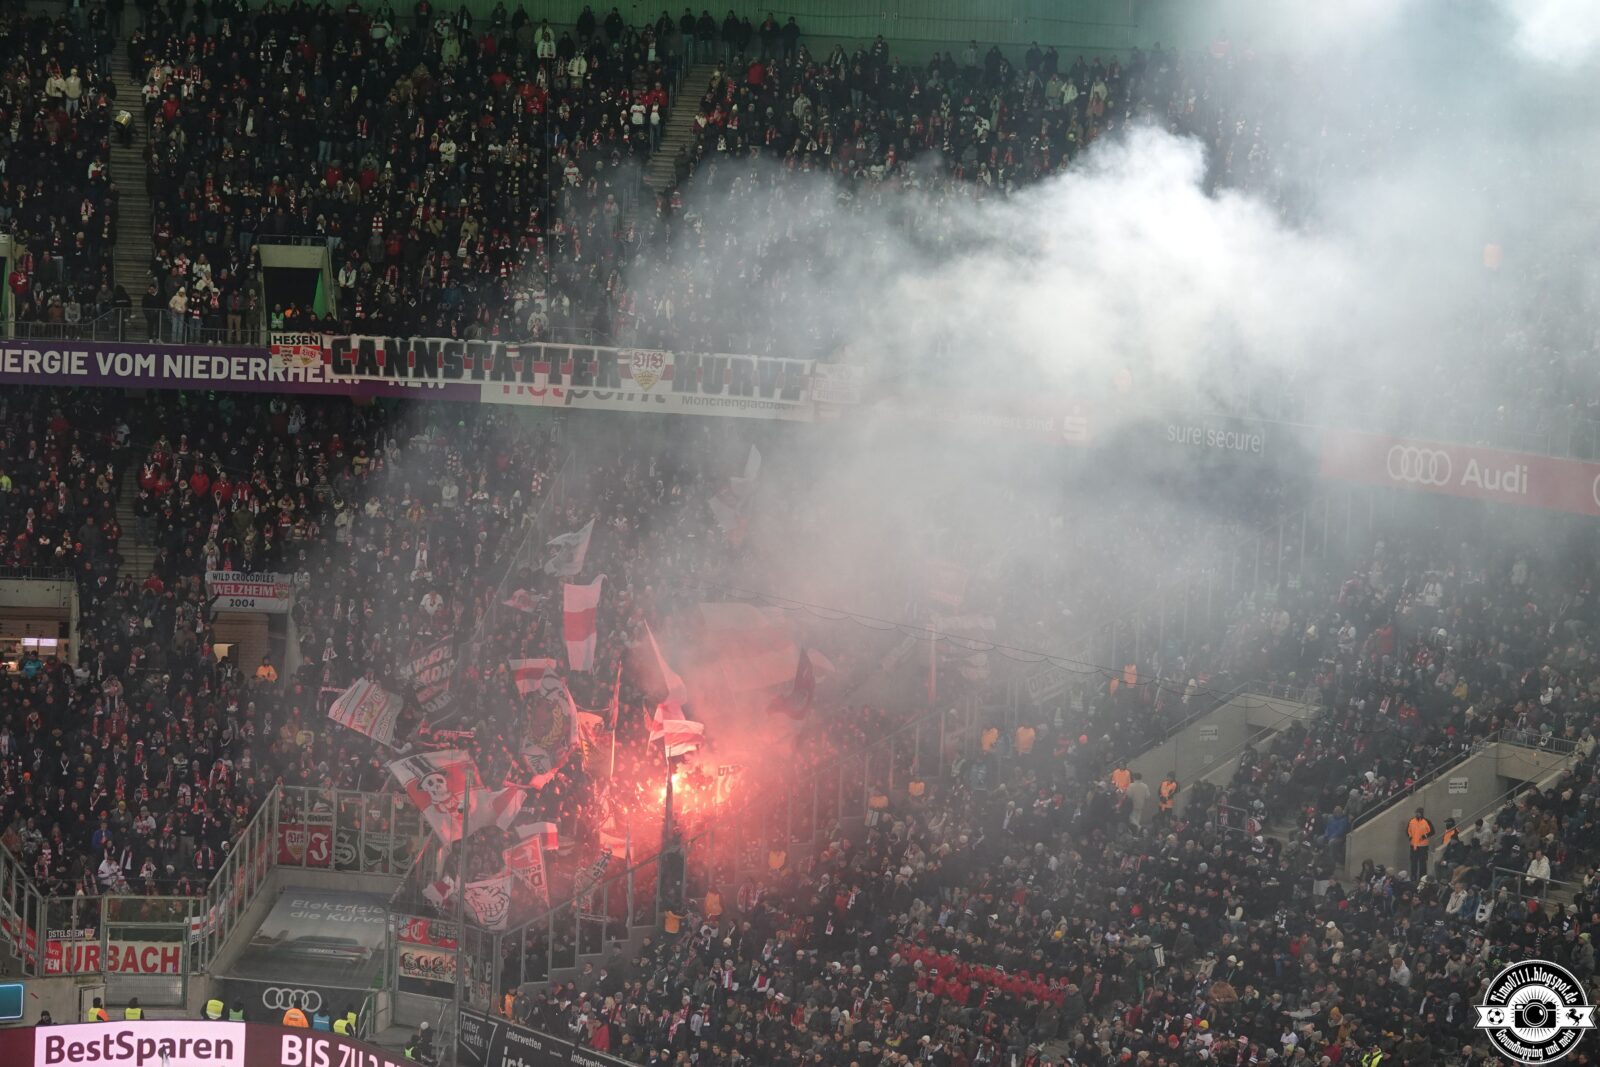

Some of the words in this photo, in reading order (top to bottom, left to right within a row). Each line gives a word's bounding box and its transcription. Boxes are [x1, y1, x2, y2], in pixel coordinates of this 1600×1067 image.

[273, 335, 319, 345] HESSEN
[0, 348, 89, 375] ERGIE
[96, 352, 156, 378] VOM
[163, 354, 360, 385] NIEDERRHE
[331, 336, 623, 389] CANNSTATTER
[1460, 458, 1529, 496] Audi
[212, 573, 230, 582] WILD
[231, 573, 275, 583] CROCODILES
[212, 584, 274, 597] WELZHEIM
[229, 599, 256, 608] 2004
[290, 900, 385, 914] Elektrisie
[289, 911, 321, 920] die
[326, 912, 385, 924] Kurve
[48, 929, 84, 938] OSTELSEIM
[65, 944, 180, 974] URBACH
[45, 1030, 234, 1066] BestSparen
[506, 1028, 542, 1051] interwetten
[281, 1034, 330, 1067] BIS
[570, 1050, 608, 1067] interwett
